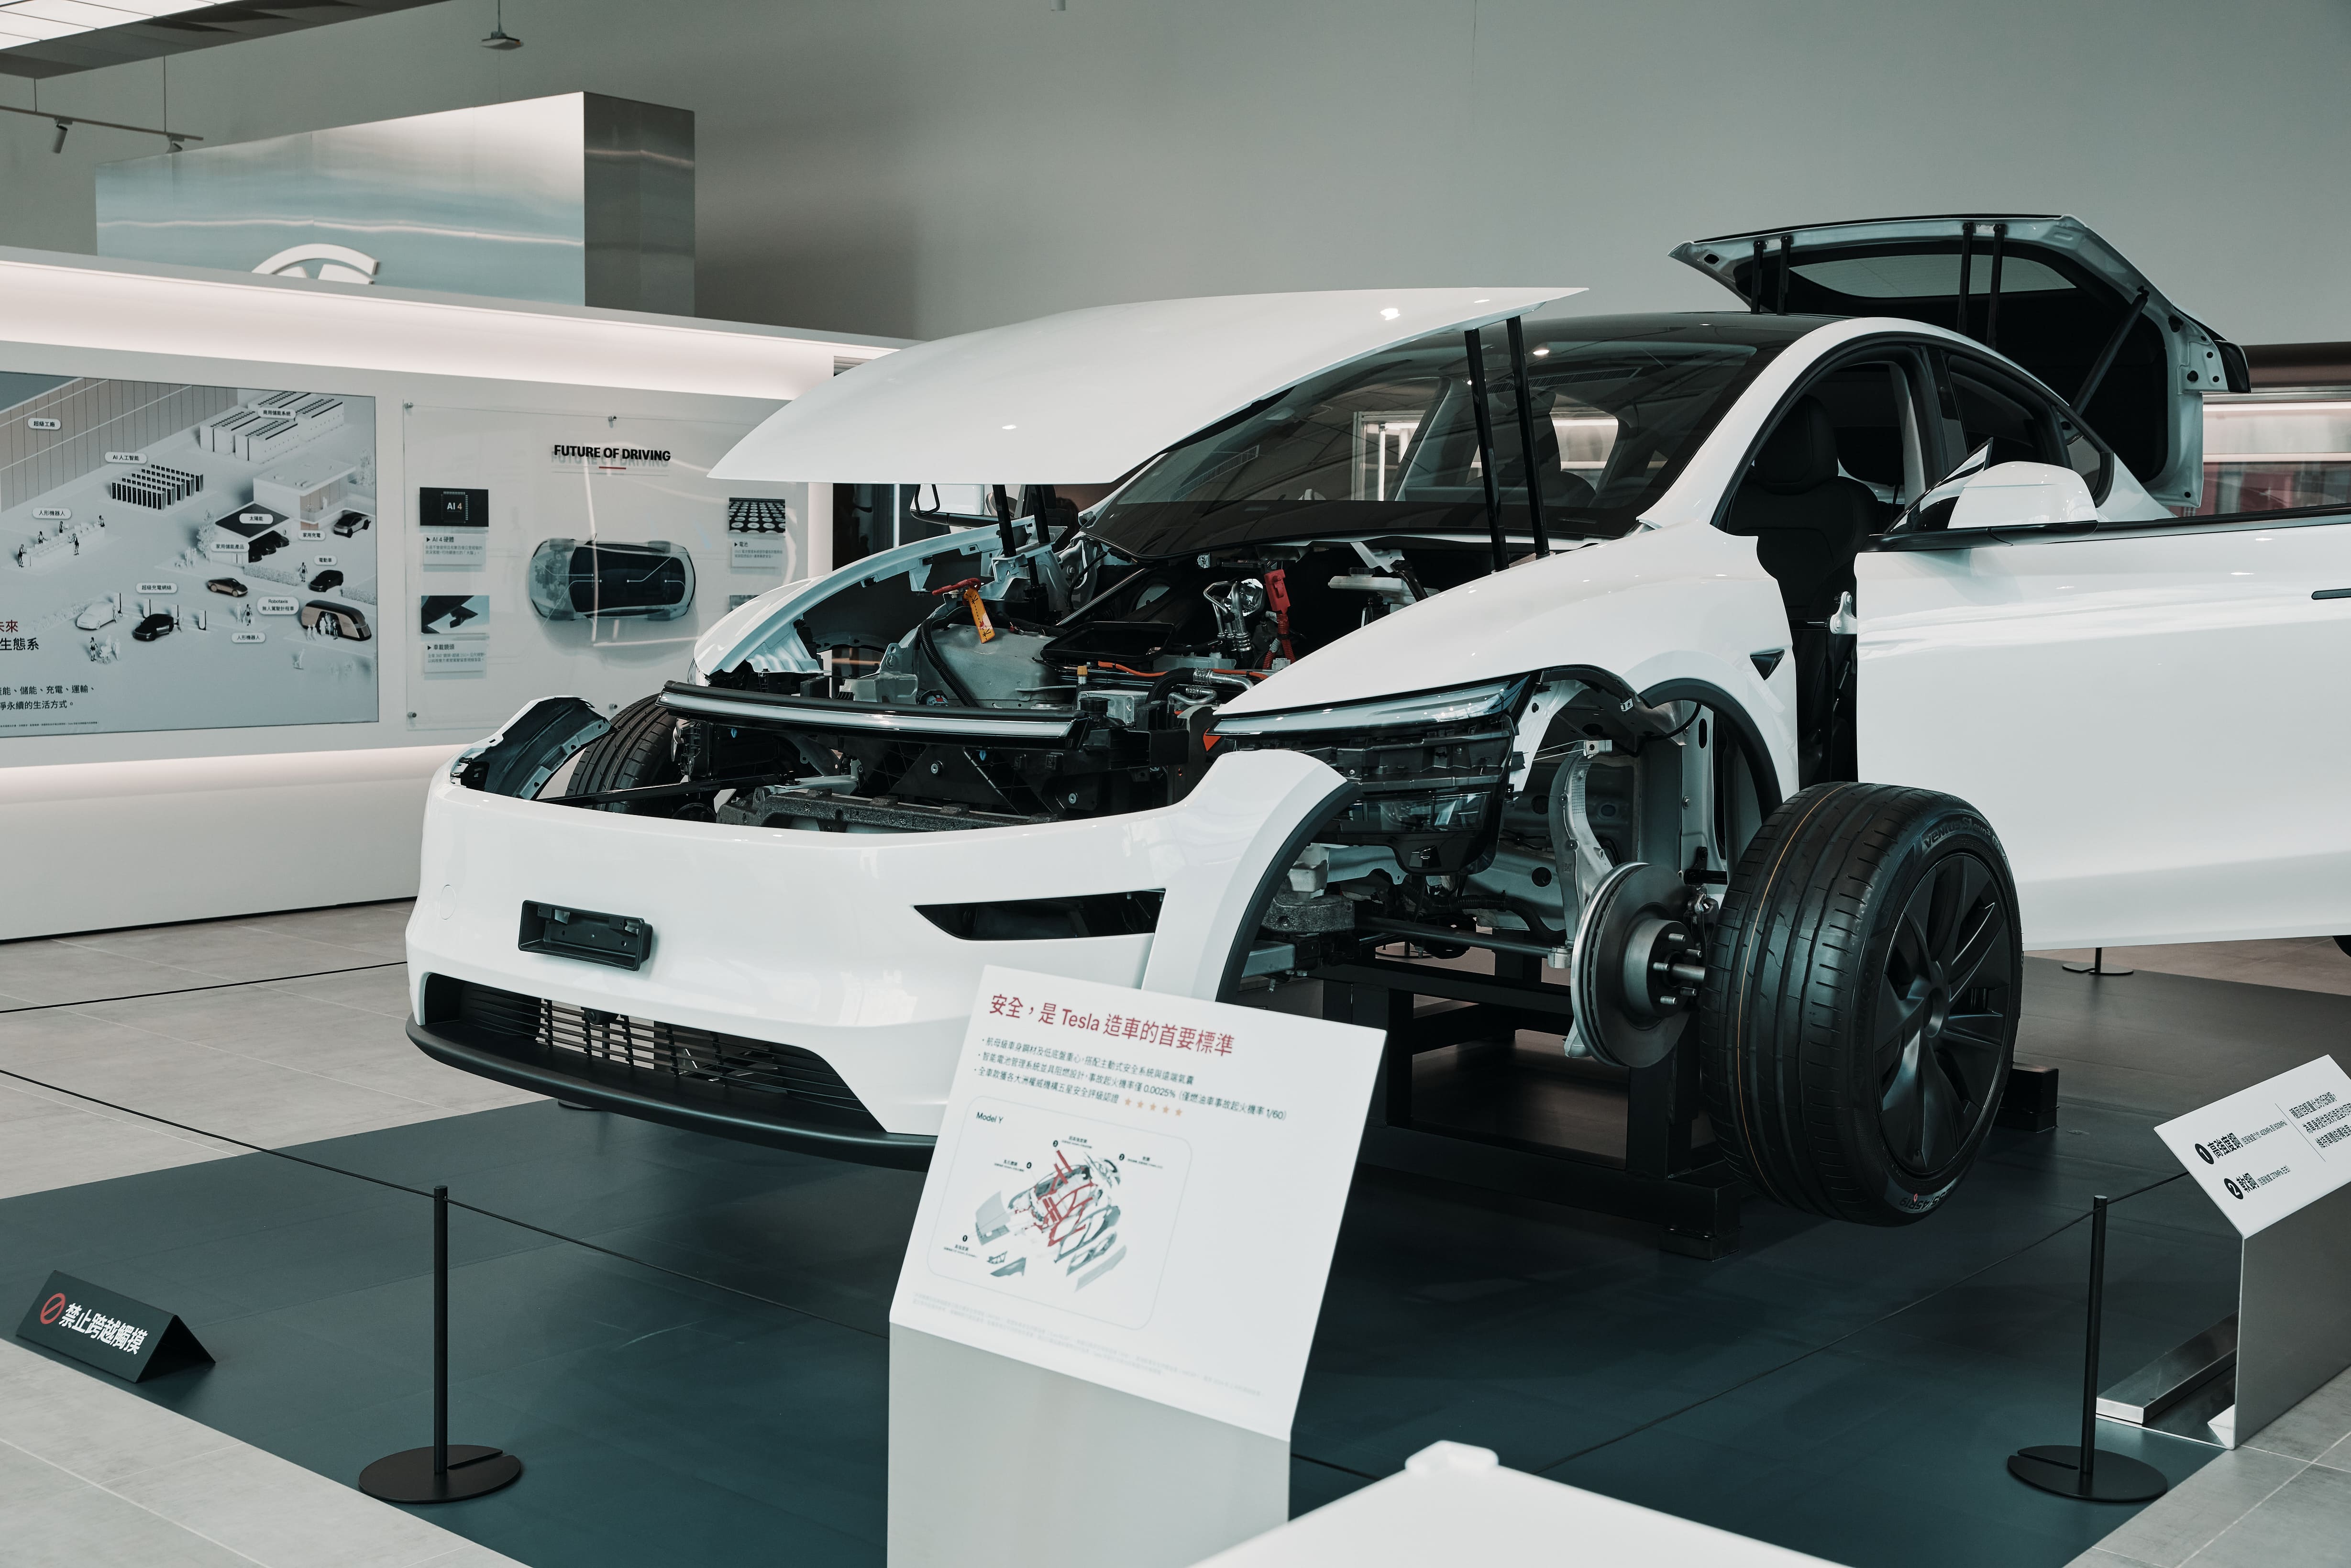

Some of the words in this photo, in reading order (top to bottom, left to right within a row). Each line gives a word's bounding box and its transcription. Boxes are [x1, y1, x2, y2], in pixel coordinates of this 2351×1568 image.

[554, 445, 600, 457] FUTURE
[603, 448, 619, 458] OF
[622, 449, 671, 461] DRIVING
[0, 685, 95, 696] 能、儲能、充電、運輸、
[989, 994, 1057, 1025] 安全，是
[1062, 1008, 1100, 1032] Tesla
[1103, 1014, 1235, 1056] 造車的首要標準
[1144, 1085, 1175, 1098] 0.0025%
[976, 1112, 997, 1123] Model
[998, 1115, 1004, 1124] Y
[2208, 1133, 2243, 1158] 高強度鋼
[2236, 1173, 2259, 1193] 軟鋼
[59, 1303, 148, 1355] 禁止跨越觸摸
